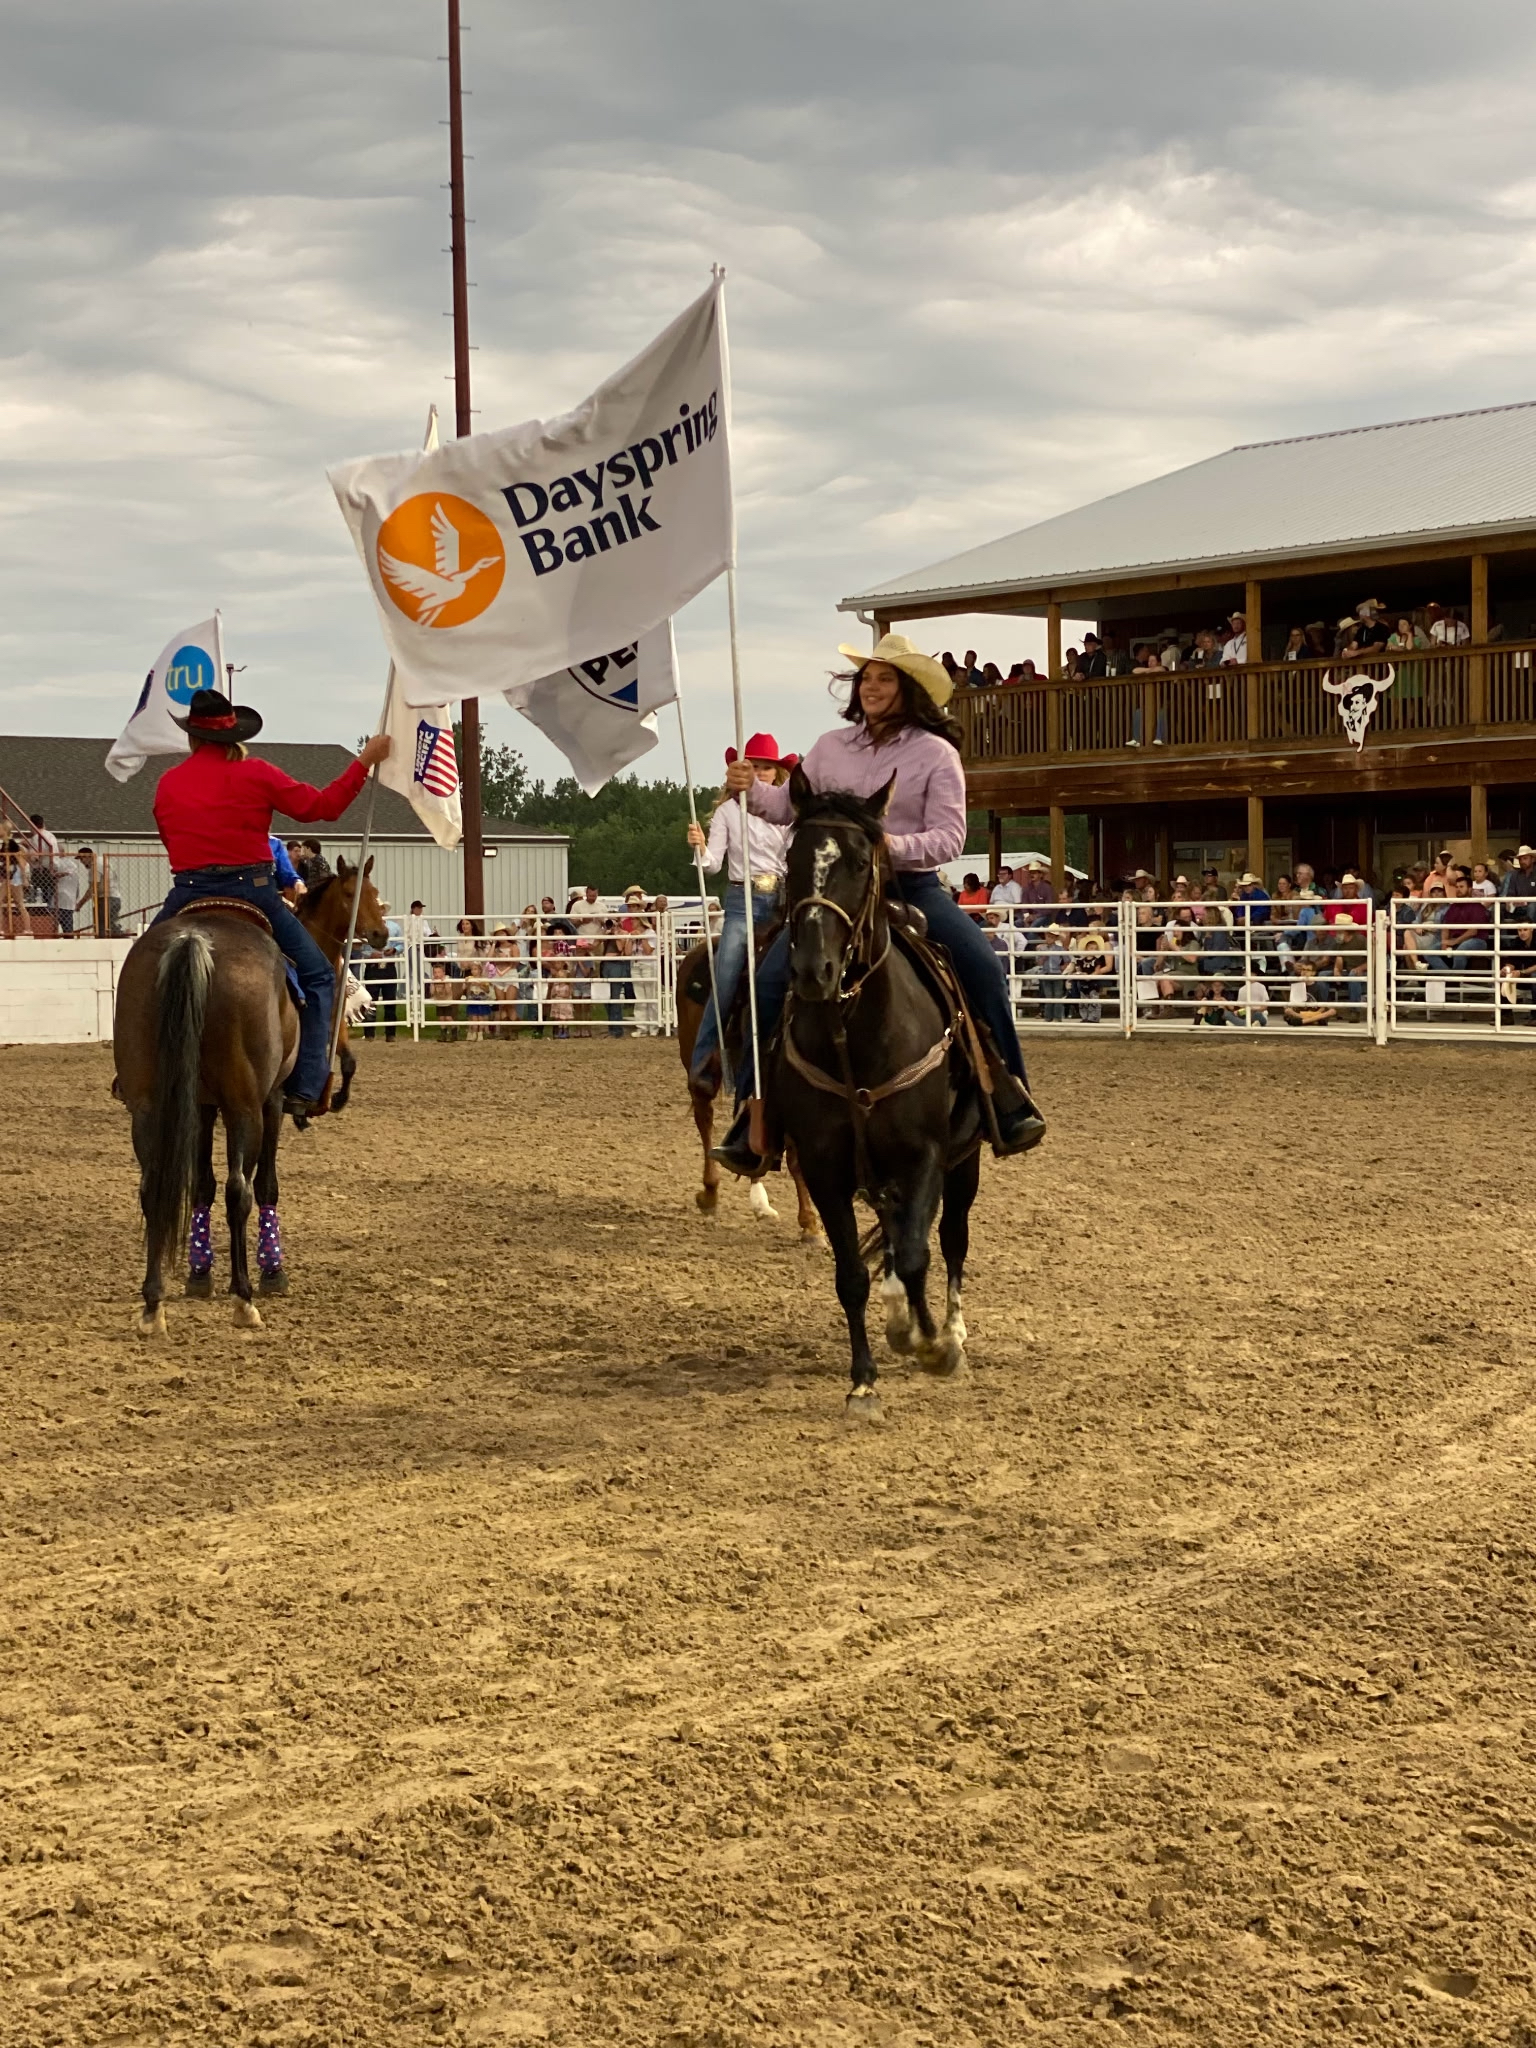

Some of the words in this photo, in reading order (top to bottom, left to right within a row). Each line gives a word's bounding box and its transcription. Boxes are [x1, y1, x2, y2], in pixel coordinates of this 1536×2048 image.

[501, 388, 718, 528] Dayspring
[519, 493, 662, 576] Bank
[167, 664, 203, 690] tru
[579, 640, 638, 685] PE
[415, 730, 424, 772] UNION
[418, 731, 434, 776] PACIFIC
